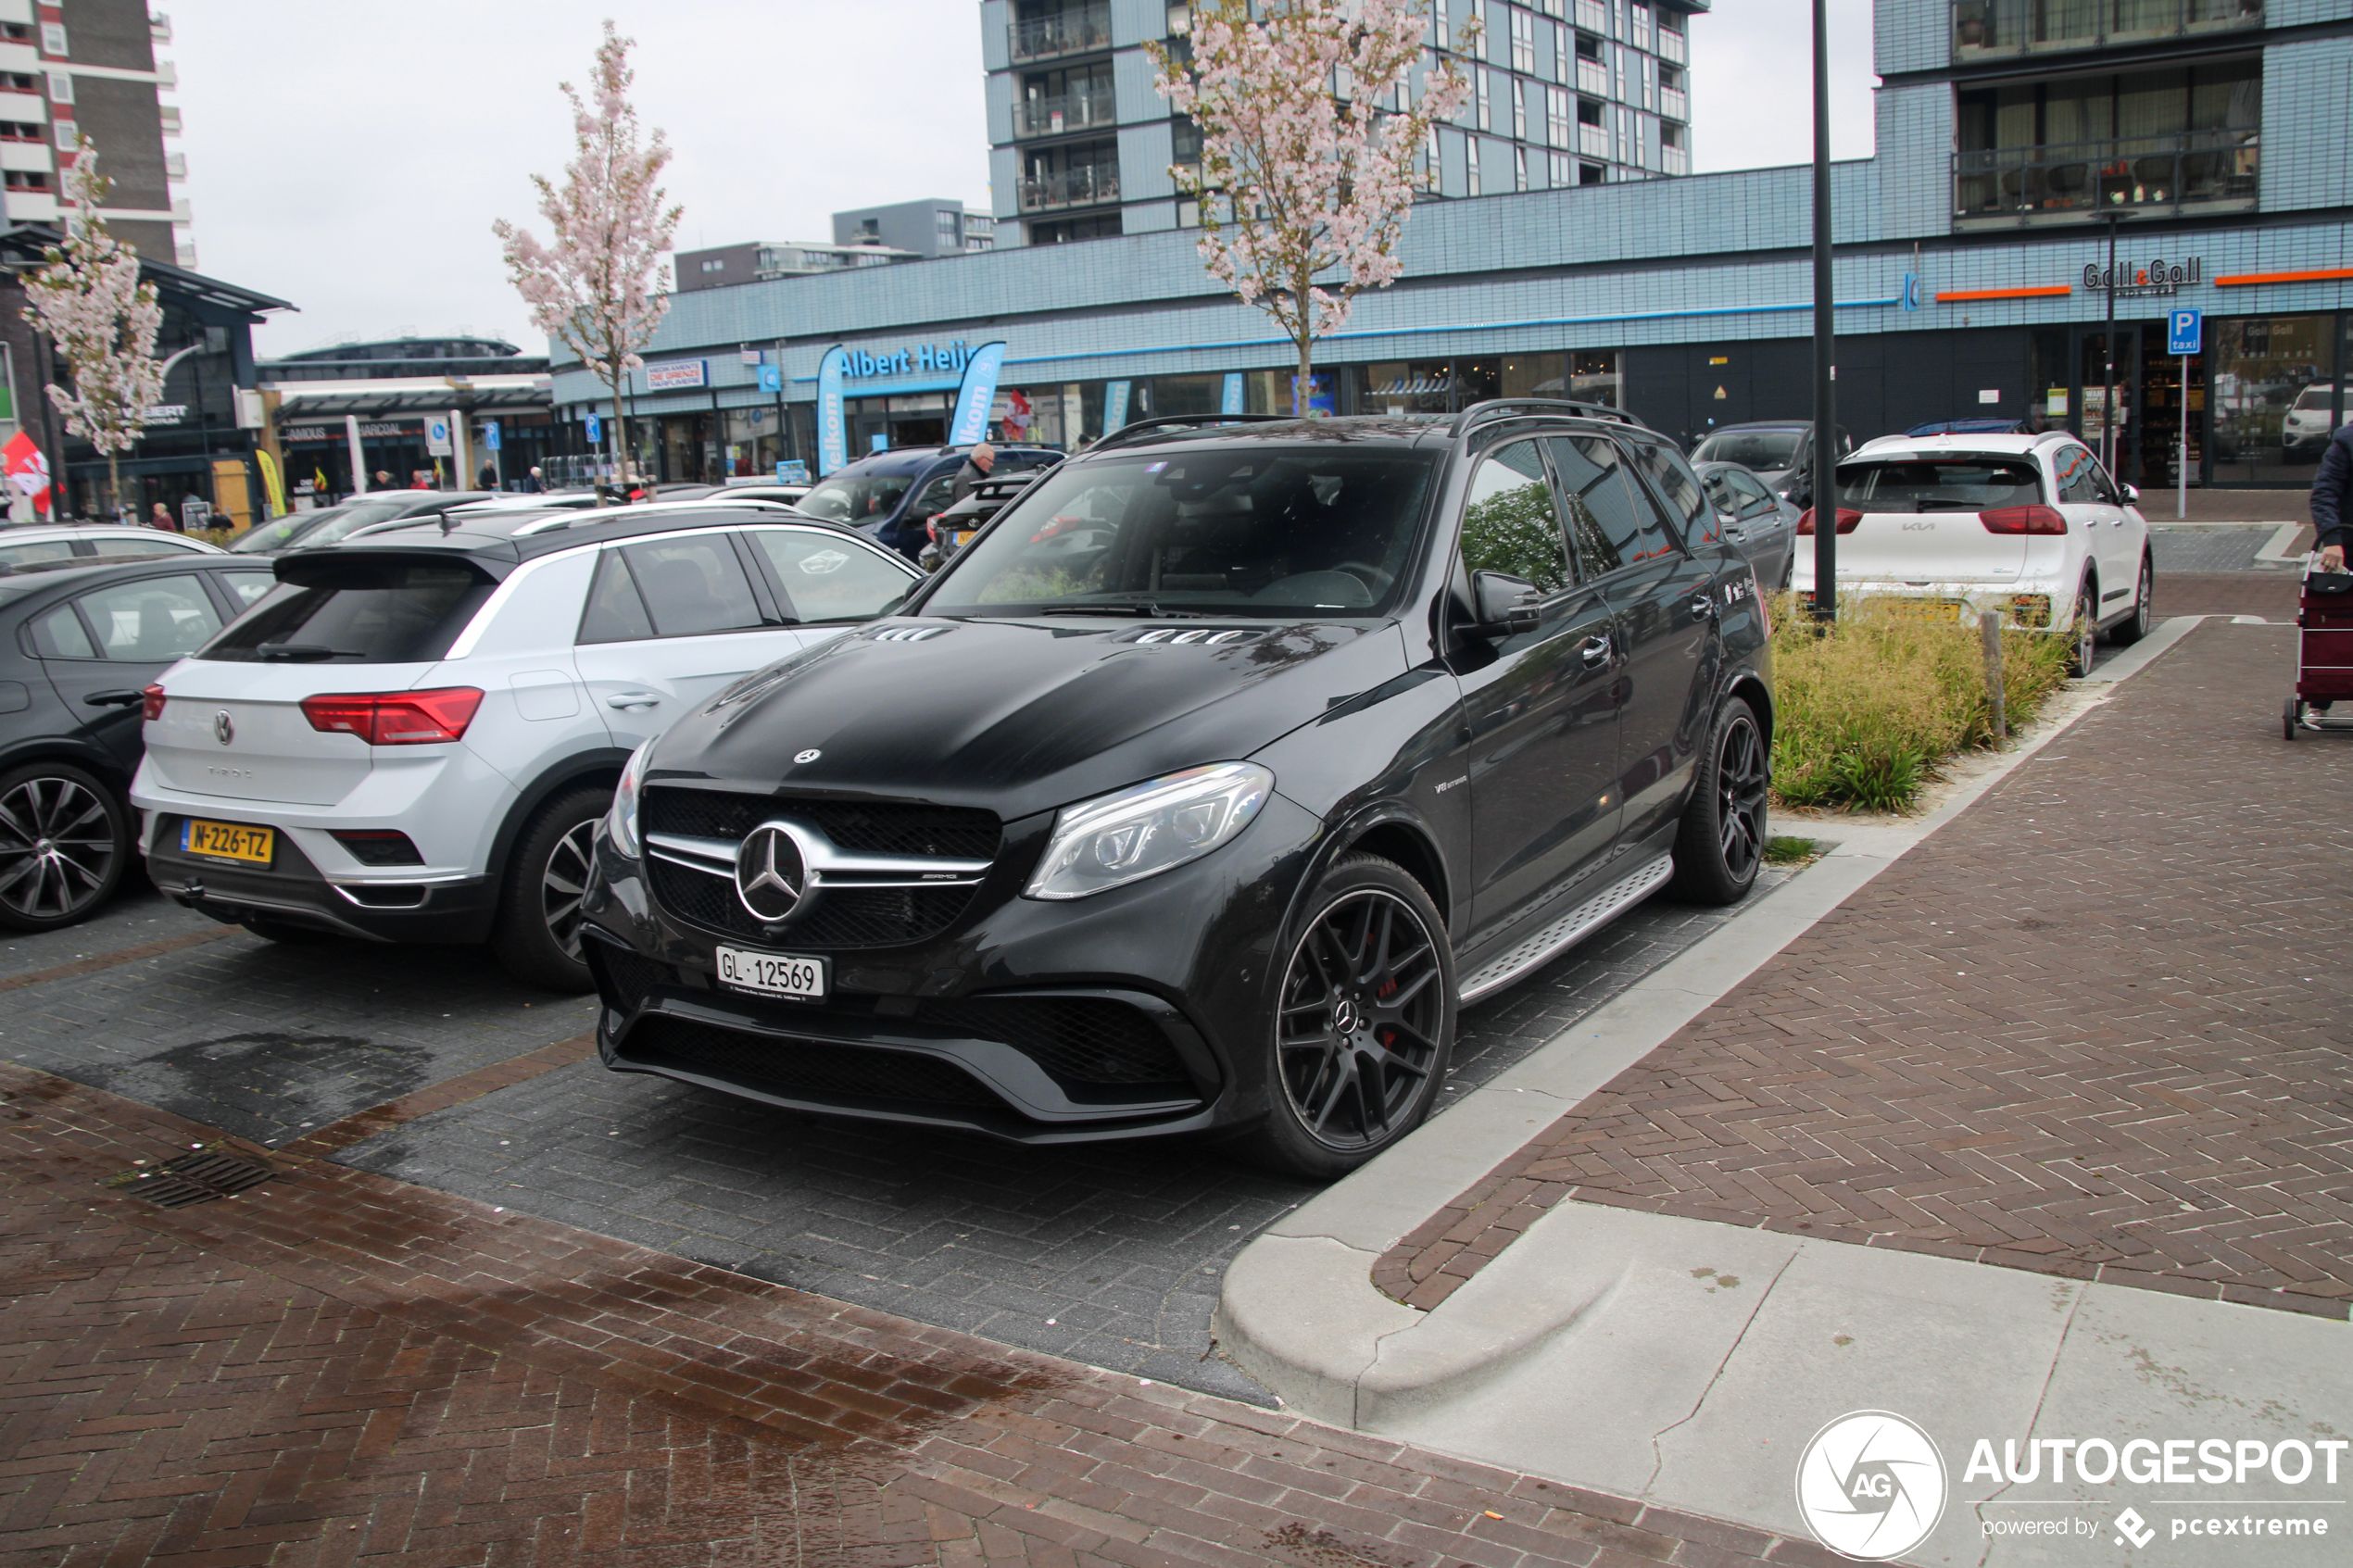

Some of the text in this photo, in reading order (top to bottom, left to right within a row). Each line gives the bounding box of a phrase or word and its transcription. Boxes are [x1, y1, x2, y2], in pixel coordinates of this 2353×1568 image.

[2177, 313, 2194, 336] P
[2173, 339, 2196, 350] taxi
[841, 347, 911, 377] Albert
[650, 370, 699, 381] DIE GRENZE
[958, 385, 988, 444] lkom
[1107, 383, 1127, 433] lkom
[359, 423, 402, 436] HARCOAL
[208, 765, 252, 779] T-ROC
[195, 824, 267, 858] N-226-TZ
